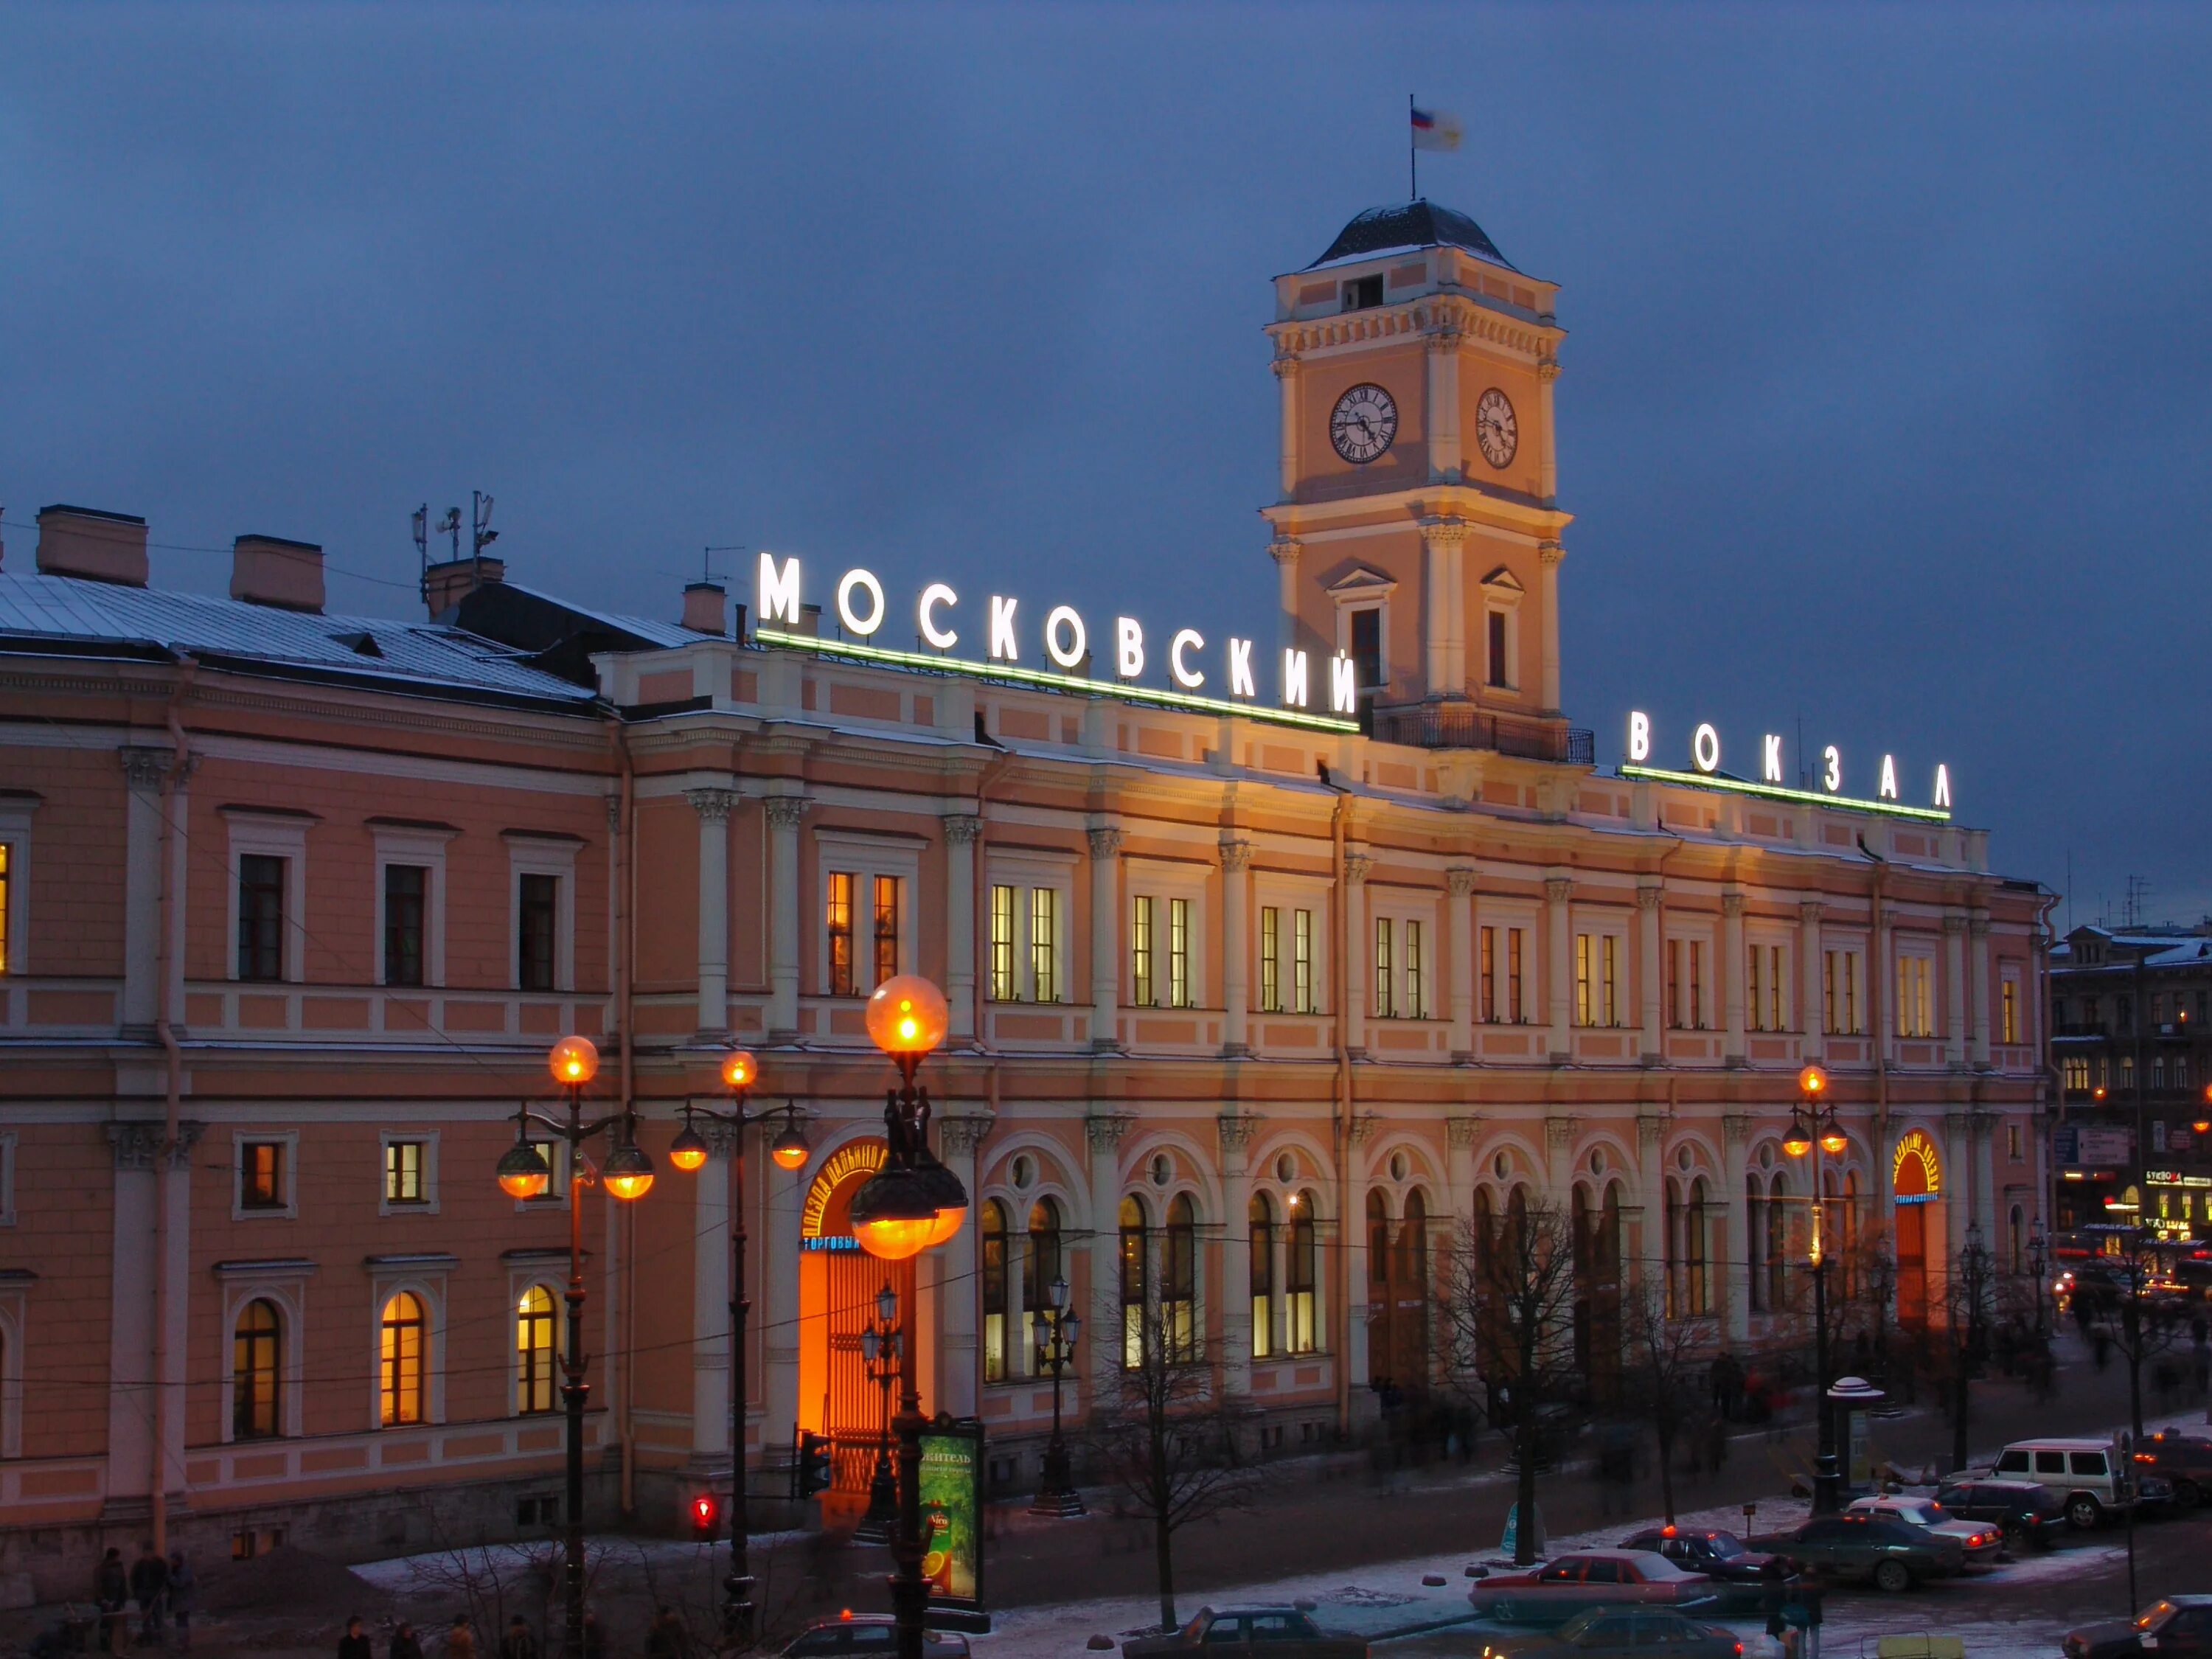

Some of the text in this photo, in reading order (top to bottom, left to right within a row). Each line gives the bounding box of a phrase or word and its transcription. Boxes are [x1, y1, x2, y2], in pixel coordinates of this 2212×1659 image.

[759, 552, 1950, 807] МОСКОВСКИЙ ВОКЗАЛ
[802, 1145, 877, 1237] ПОЕЗДА ДАЛЬНЕГО
